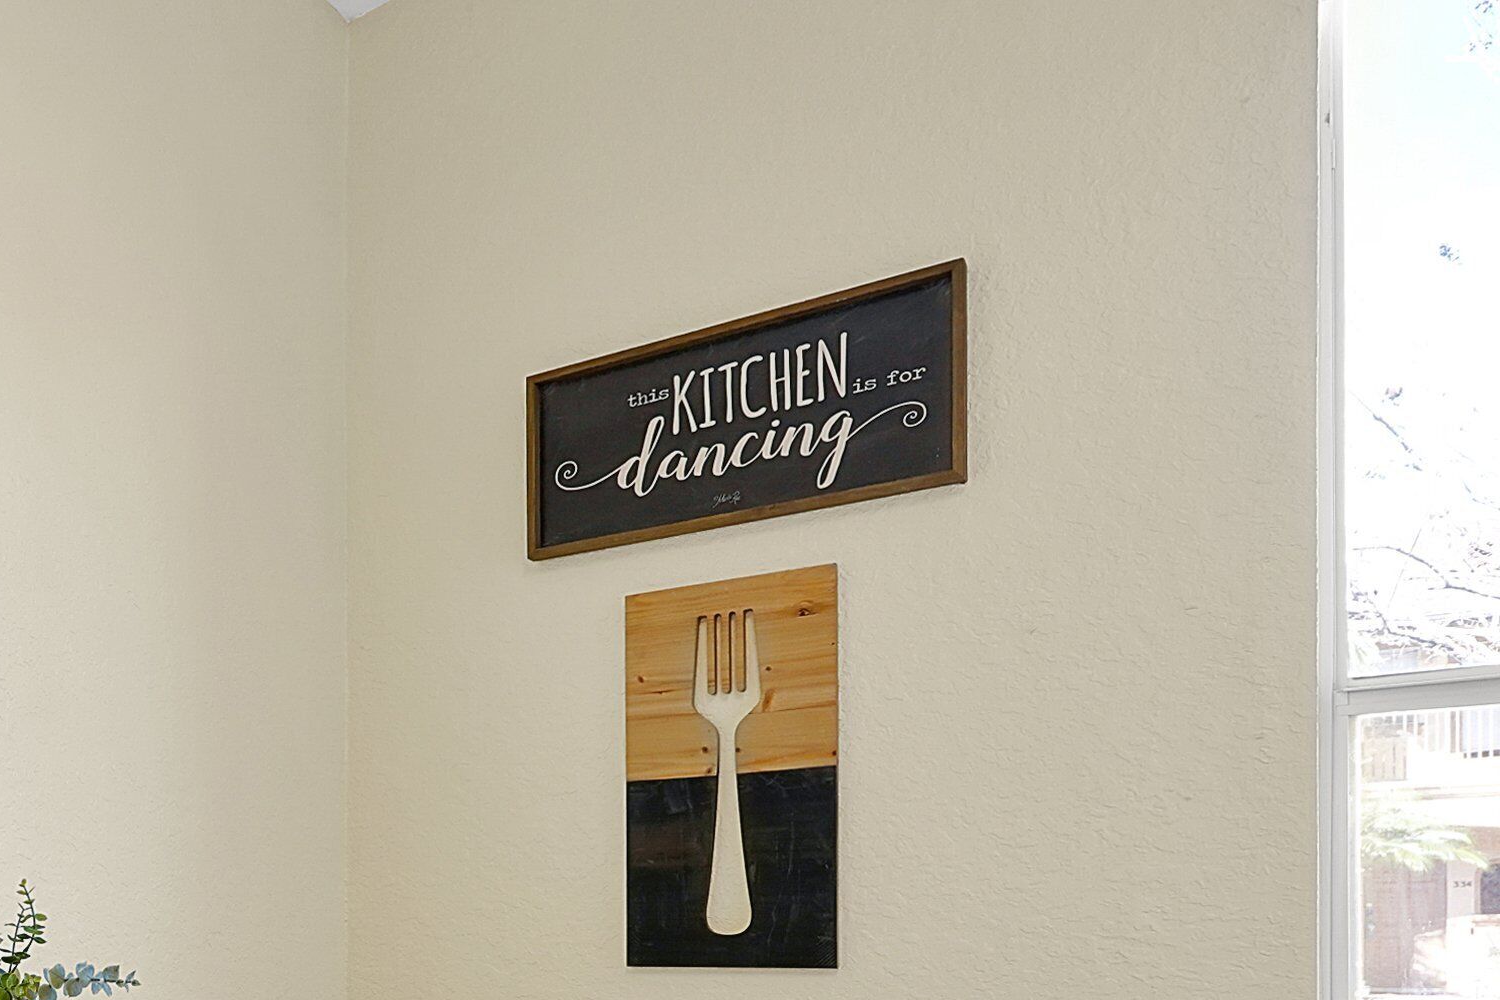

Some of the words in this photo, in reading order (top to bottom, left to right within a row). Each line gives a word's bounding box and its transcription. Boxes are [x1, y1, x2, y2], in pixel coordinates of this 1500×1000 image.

[627, 388, 669, 408] this
[672, 332, 848, 435] KITCHEN
[852, 378, 877, 394] is
[886, 366, 927, 387] for
[615, 409, 854, 498] dancing
